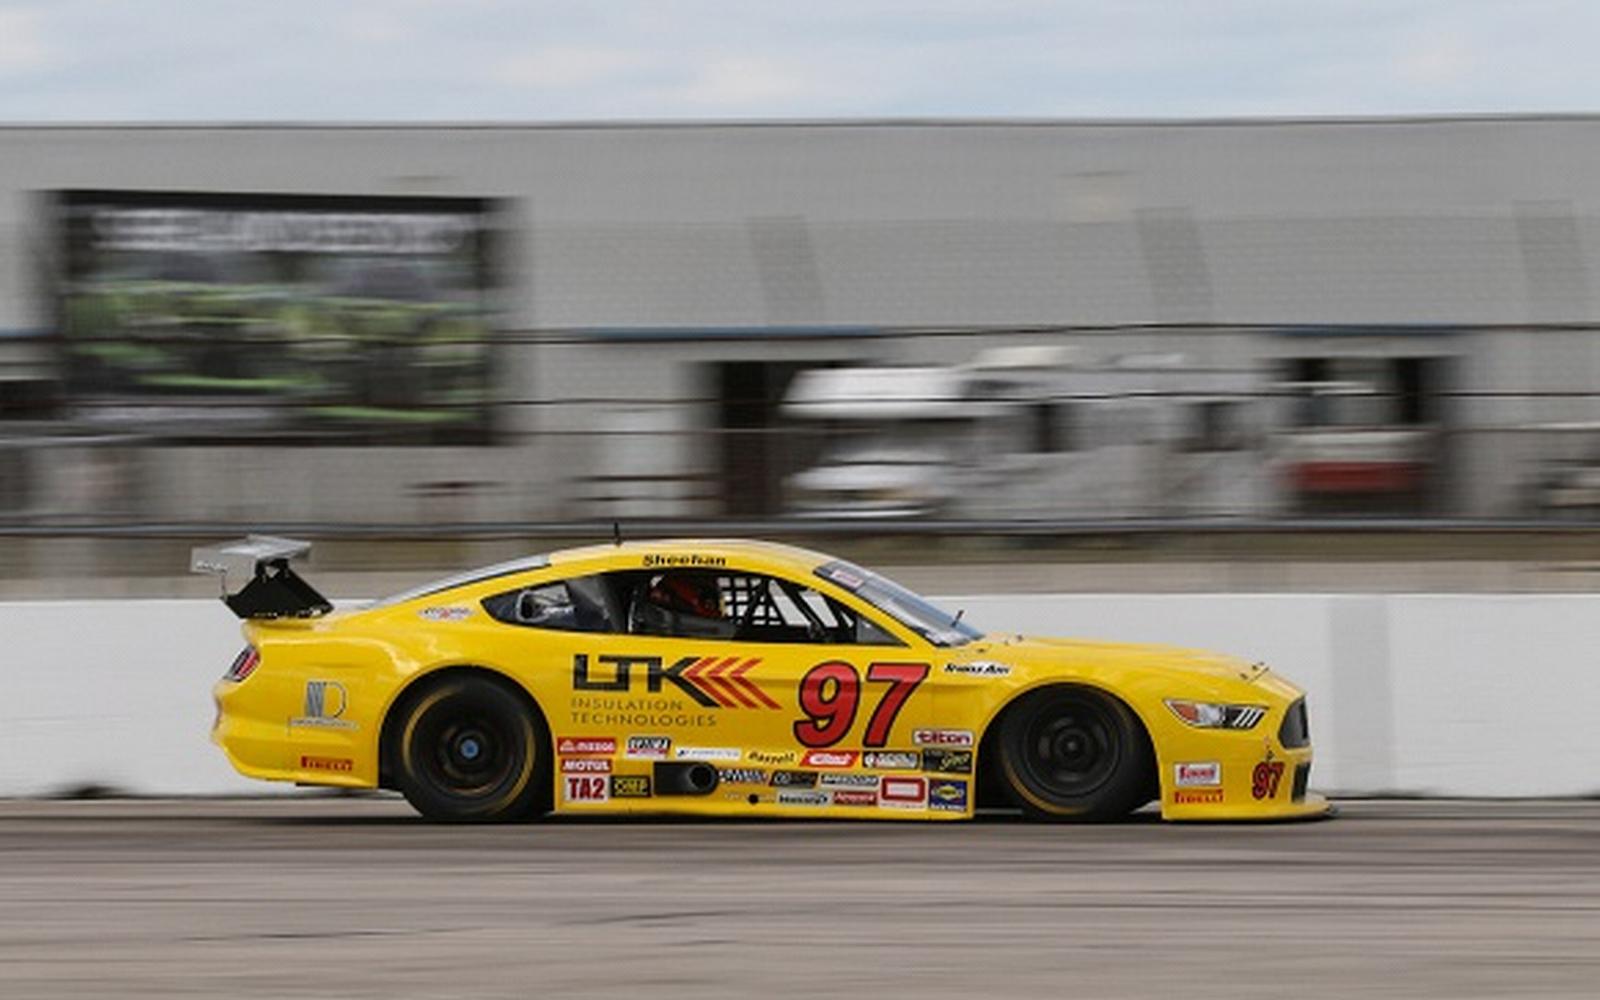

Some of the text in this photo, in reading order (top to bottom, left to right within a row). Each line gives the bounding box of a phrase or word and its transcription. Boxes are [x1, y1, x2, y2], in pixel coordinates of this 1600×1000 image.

[643, 554, 726, 567] Sheehan
[573, 654, 720, 708] LTK
[571, 698, 683, 711] INSULATION
[793, 660, 931, 748] 97
[571, 712, 717, 727] TECHNOLOGIES
[568, 777, 605, 799] TA2
[1252, 762, 1285, 800] 97
